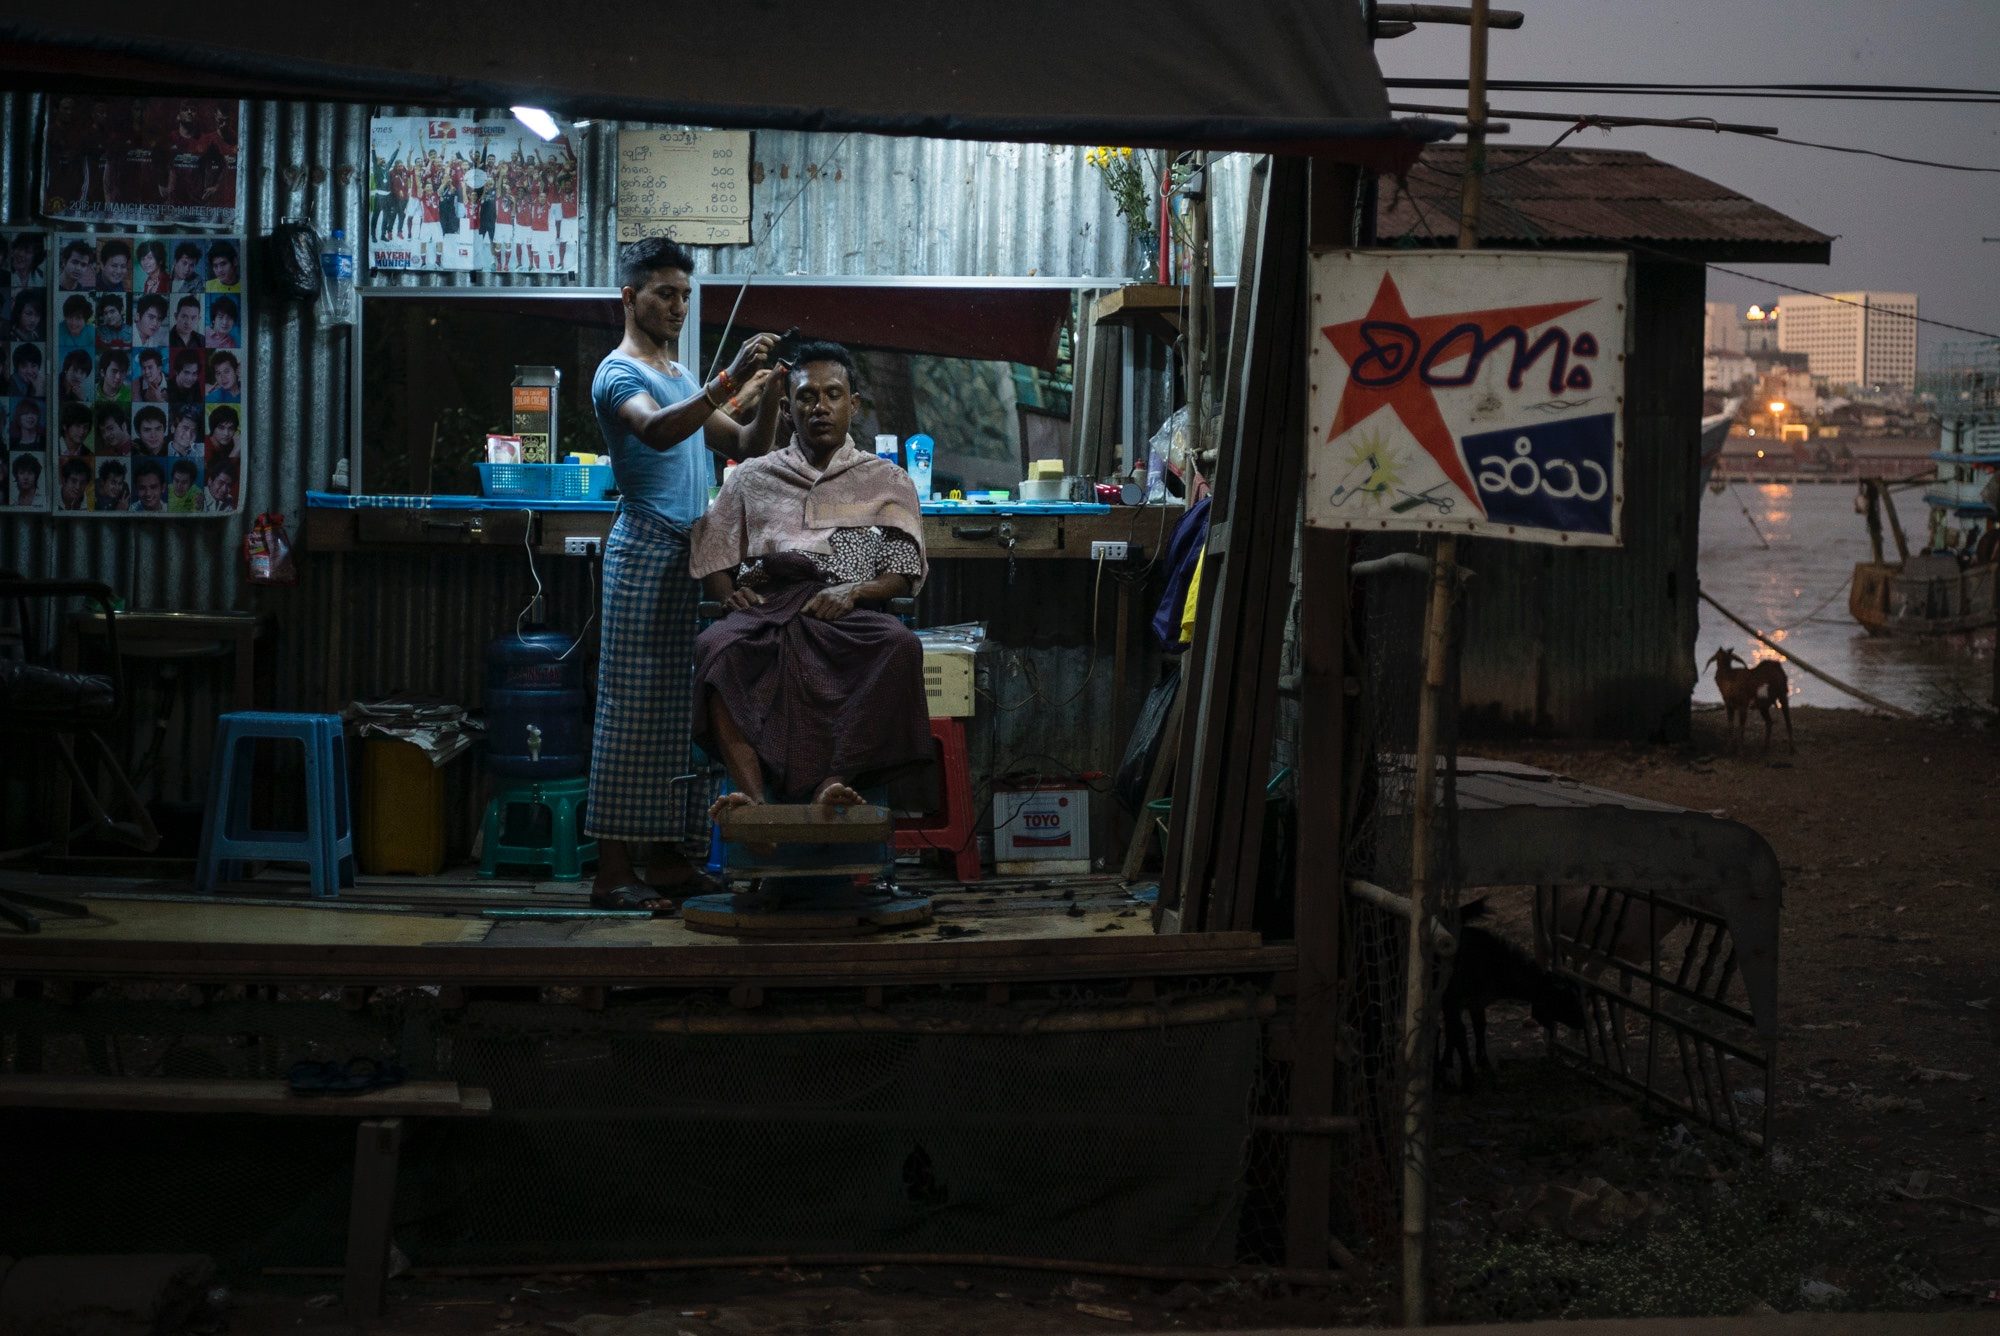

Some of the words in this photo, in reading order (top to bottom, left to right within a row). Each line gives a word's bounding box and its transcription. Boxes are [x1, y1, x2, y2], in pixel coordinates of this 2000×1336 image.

[712, 149, 733, 158] 800
[711, 166, 735, 176] 500
[711, 181, 735, 191] 400
[711, 193, 737, 203] 800
[705, 204, 738, 214] 1000
[706, 227, 730, 239] 700
[374, 251, 411, 260] BAYERN
[374, 259, 411, 268] MUNICH
[1478, 435, 1609, 502] ဆံသ
[1022, 814, 1060, 827] TOYO
